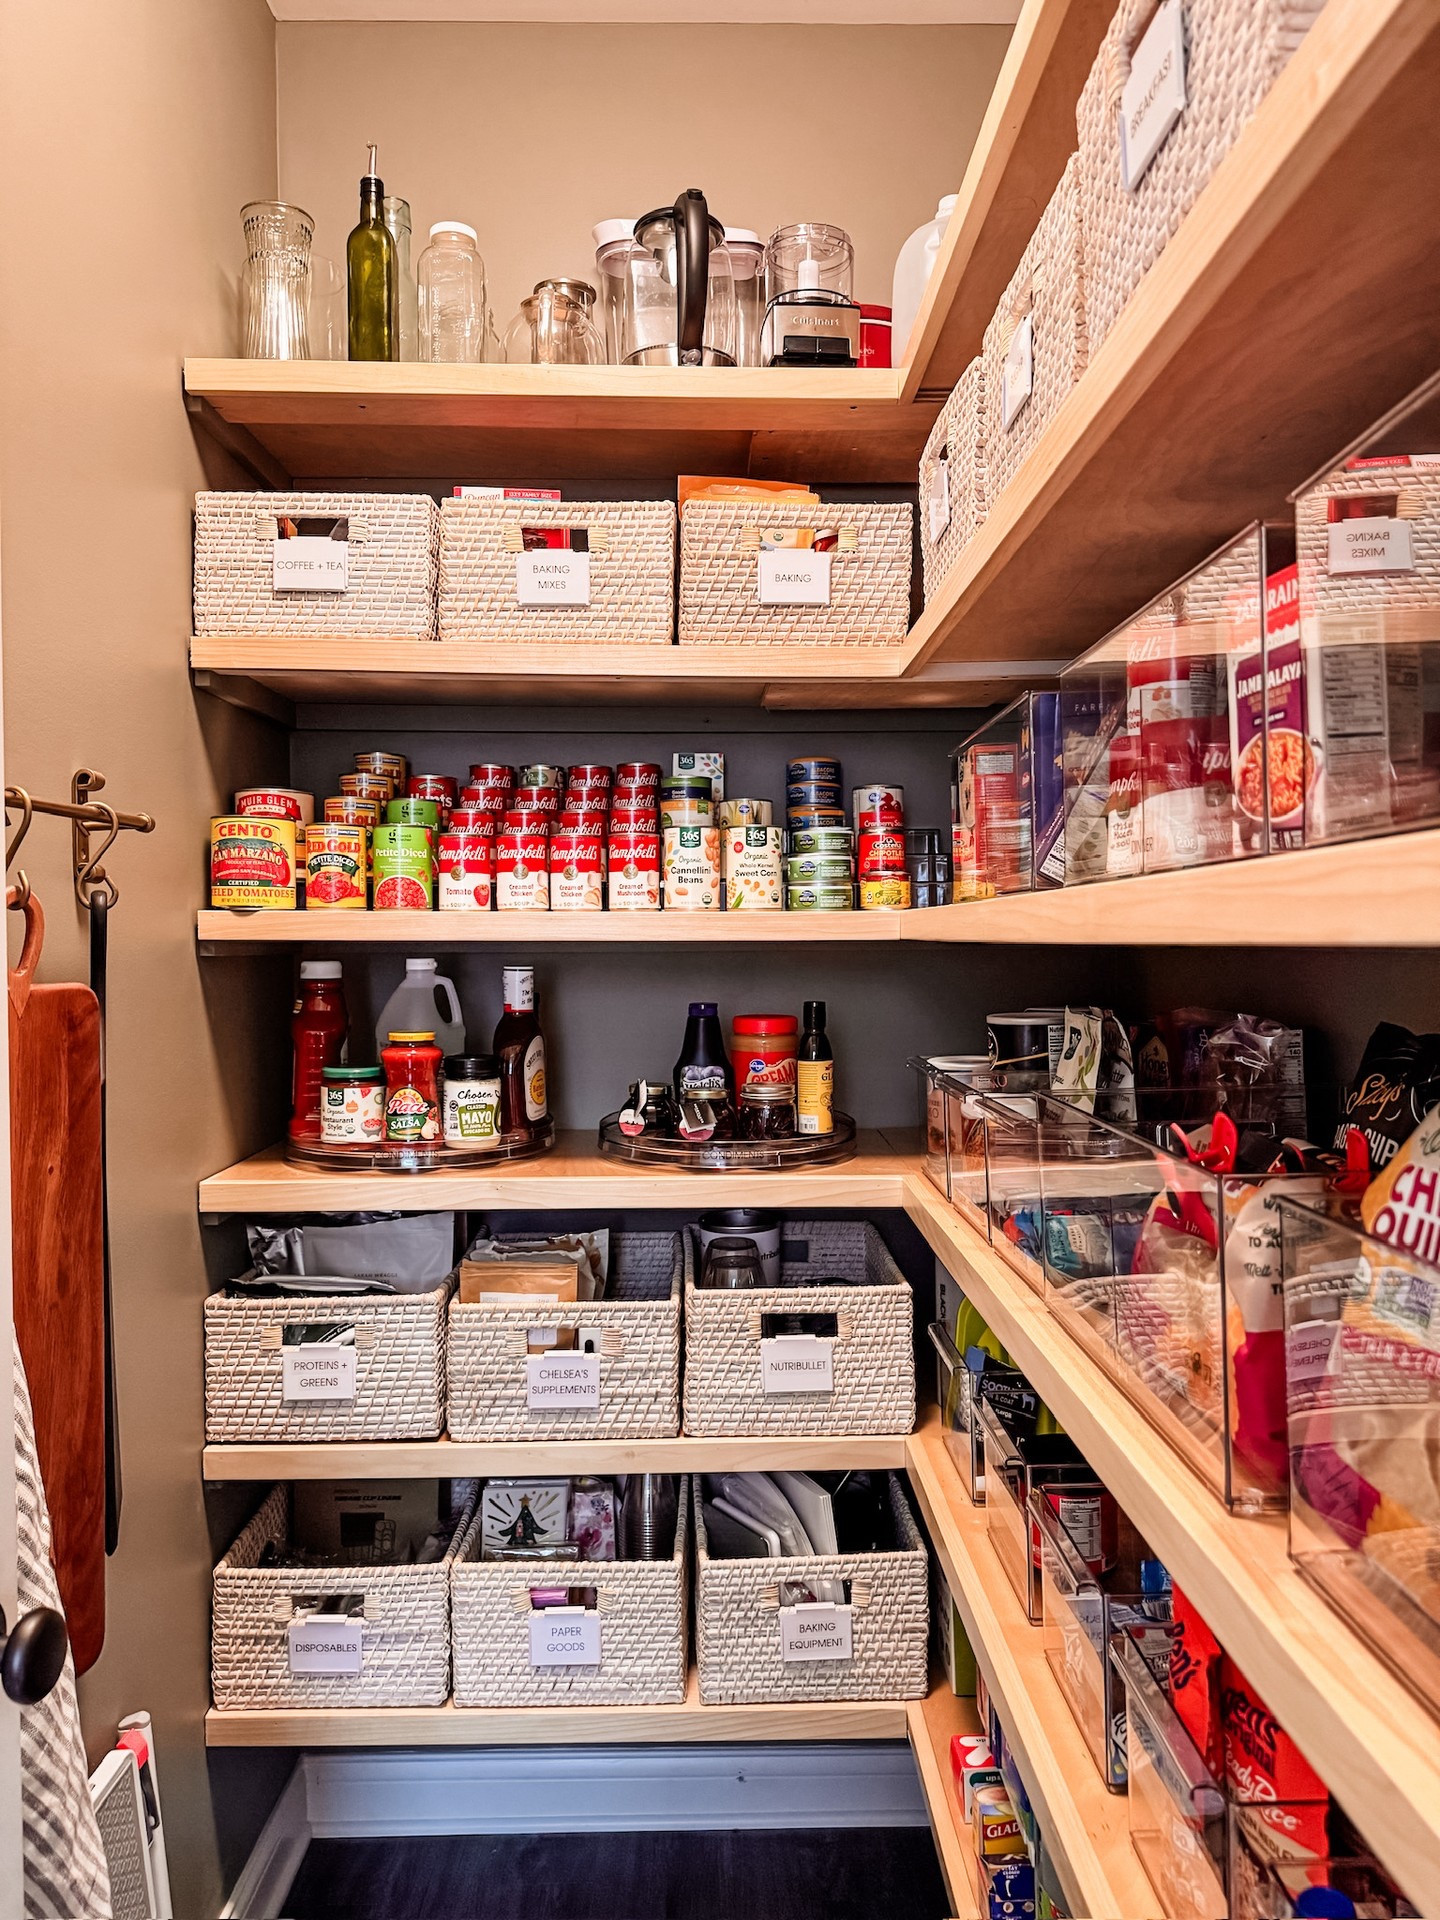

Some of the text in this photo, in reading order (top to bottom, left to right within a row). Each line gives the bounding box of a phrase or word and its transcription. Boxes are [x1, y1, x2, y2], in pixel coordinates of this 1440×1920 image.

[1130, 49, 1172, 139] BREAKFAST
[792, 316, 840, 326] Cuisinart
[276, 560, 314, 572] COFFEE
[325, 560, 344, 571] TEA
[532, 564, 570, 575] BAKING
[774, 572, 812, 583] BAKING
[537, 579, 567, 590] MIXES
[241, 795, 293, 808] MUIR GLEN
[218, 823, 273, 839] CENTO
[610, 818, 656, 833] Campbell's
[681, 831, 700, 841] 365
[747, 829, 766, 841] 365
[327, 839, 361, 853] GOLD
[230, 847, 283, 865] MARZANO
[375, 848, 428, 858] Petite Diced
[438, 844, 487, 862] Campbell's
[496, 843, 546, 862] Campbell's
[550, 844, 598, 863] Campbell's
[608, 843, 657, 862] Campbell's
[744, 851, 769, 862] Organic
[310, 854, 355, 867] PETITE DICED
[670, 866, 712, 875] Cannellini
[734, 869, 778, 877] Sweet Corn
[677, 875, 704, 884] Beans
[236, 888, 290, 898] TOMATOES
[446, 887, 472, 896] Tomato
[328, 1091, 343, 1101] 365
[457, 1089, 493, 1100] Chosen
[387, 1098, 430, 1114] Pace
[460, 1110, 492, 1125] MAYO
[327, 1124, 343, 1132] Style
[390, 1118, 421, 1130] SALSA
[702, 1150, 765, 1160] CONDIMENTS
[939, 1283, 947, 1319] BLACK
[293, 1360, 339, 1371] PROTEINS
[770, 1360, 827, 1372] NUTRIBULLET
[539, 1368, 589, 1380] CHELSEA'S
[299, 1377, 339, 1388] GREENS
[531, 1383, 597, 1396] SUPPLEMENTS
[550, 1626, 582, 1637] PAPER
[799, 1621, 836, 1633] BAKING
[295, 1643, 357, 1653] DISPOSABLES
[546, 1641, 585, 1652] GOODS
[788, 1637, 844, 1650] EQUIPMENT
[986, 1824, 1021, 1839] GLAD
